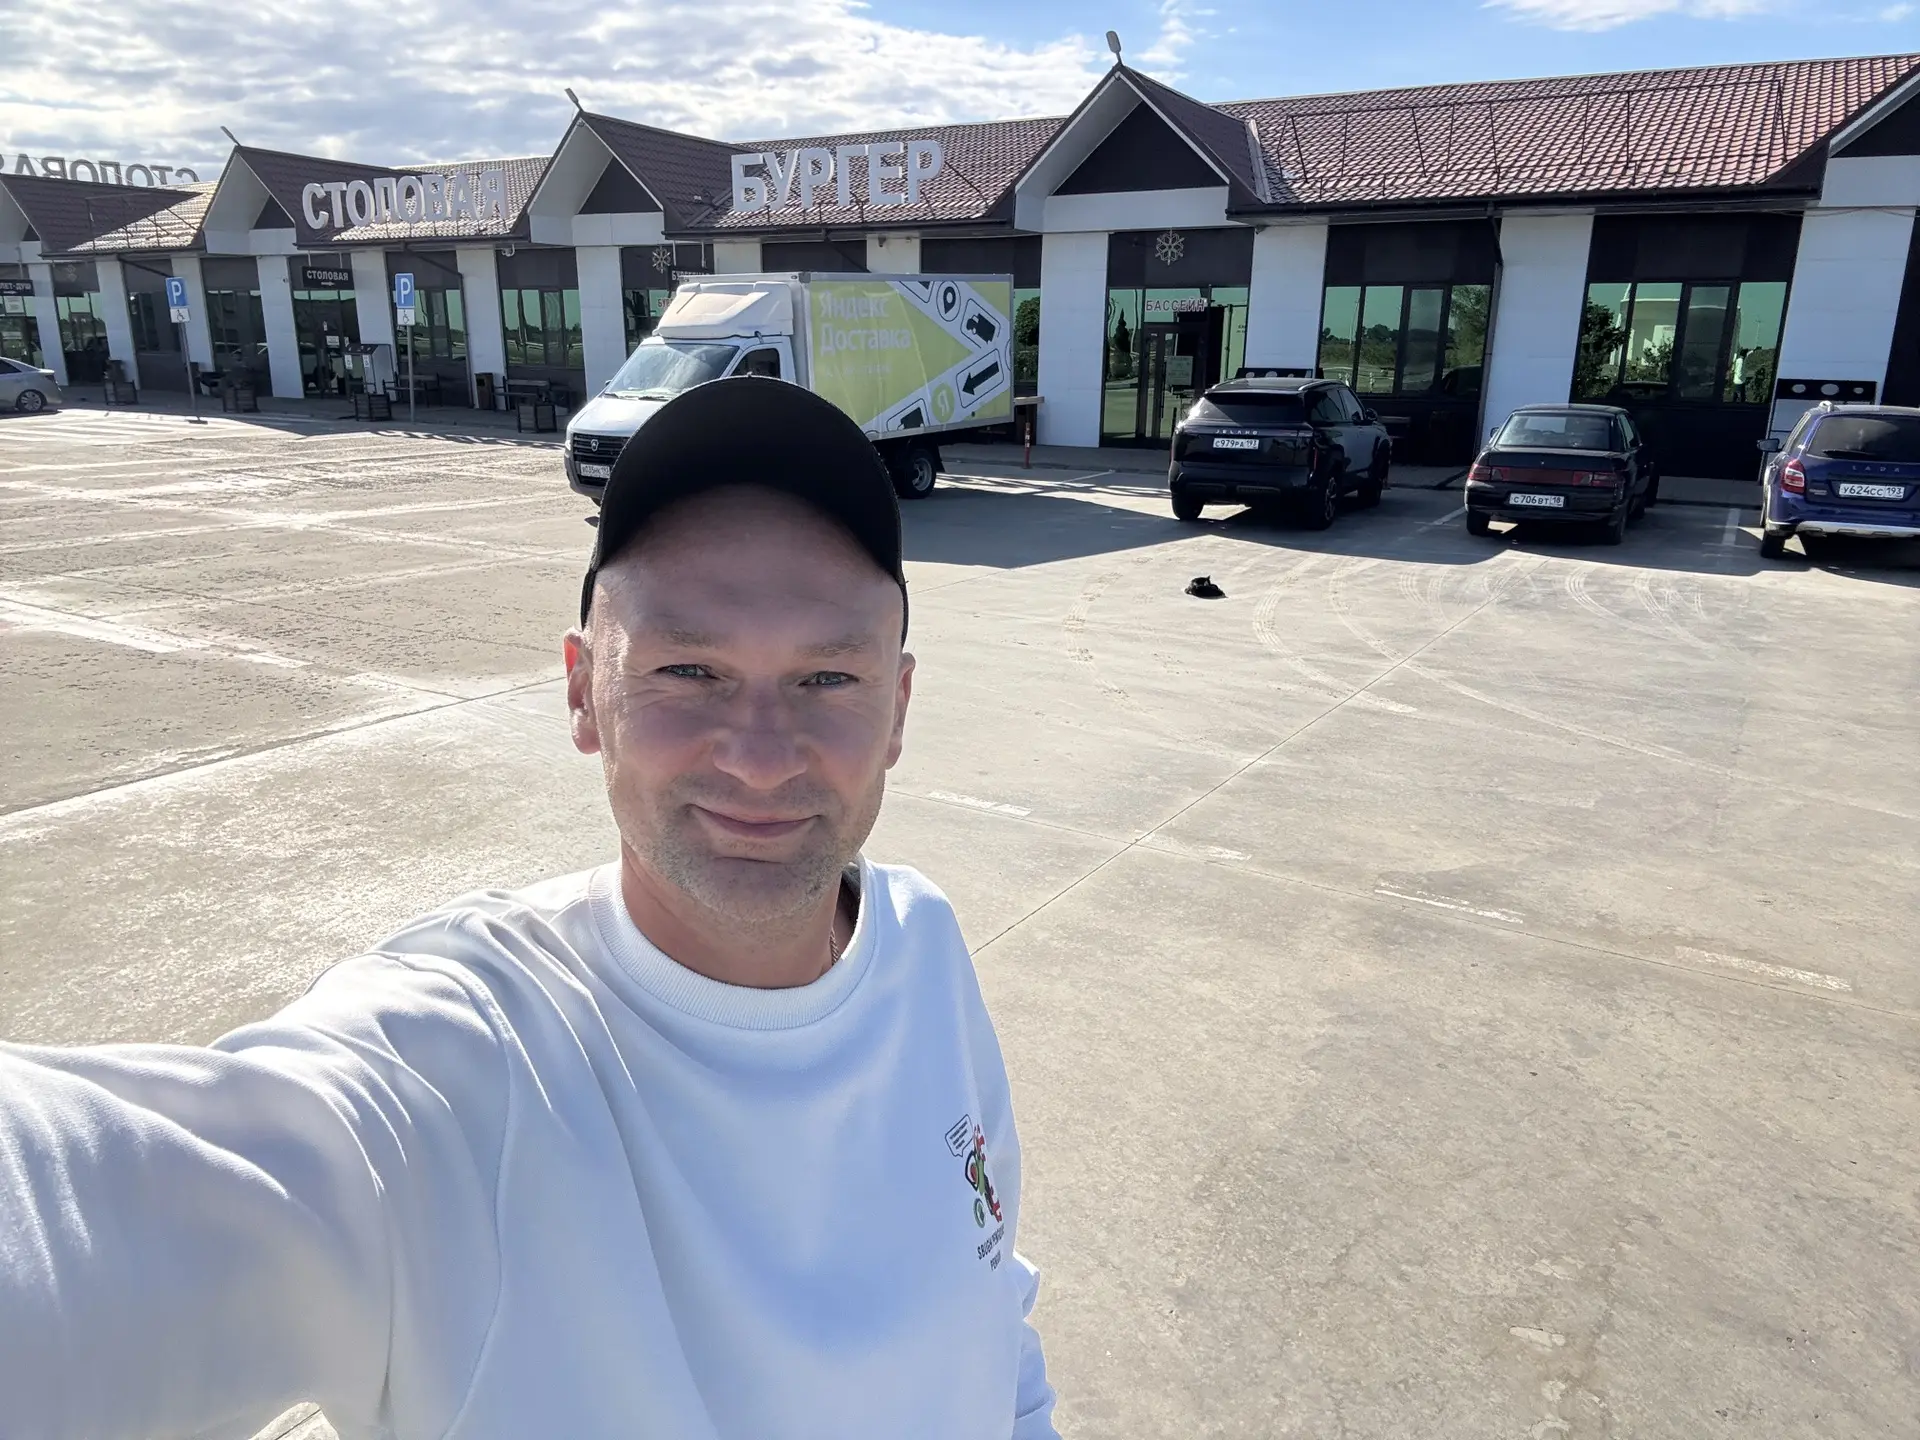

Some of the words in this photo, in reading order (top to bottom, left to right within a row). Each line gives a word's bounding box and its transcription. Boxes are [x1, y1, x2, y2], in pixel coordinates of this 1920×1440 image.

[731, 139, 945, 212] БУРГЕР
[302, 168, 508, 229] СТОЛОВАЯ
[306, 270, 349, 281] СТОЛОВАЯ
[171, 281, 182, 304] P
[401, 278, 411, 304] P
[1146, 297, 1205, 312] БАССЕЙН
[820, 290, 889, 322] Яндекс
[820, 323, 912, 357] Доставка
